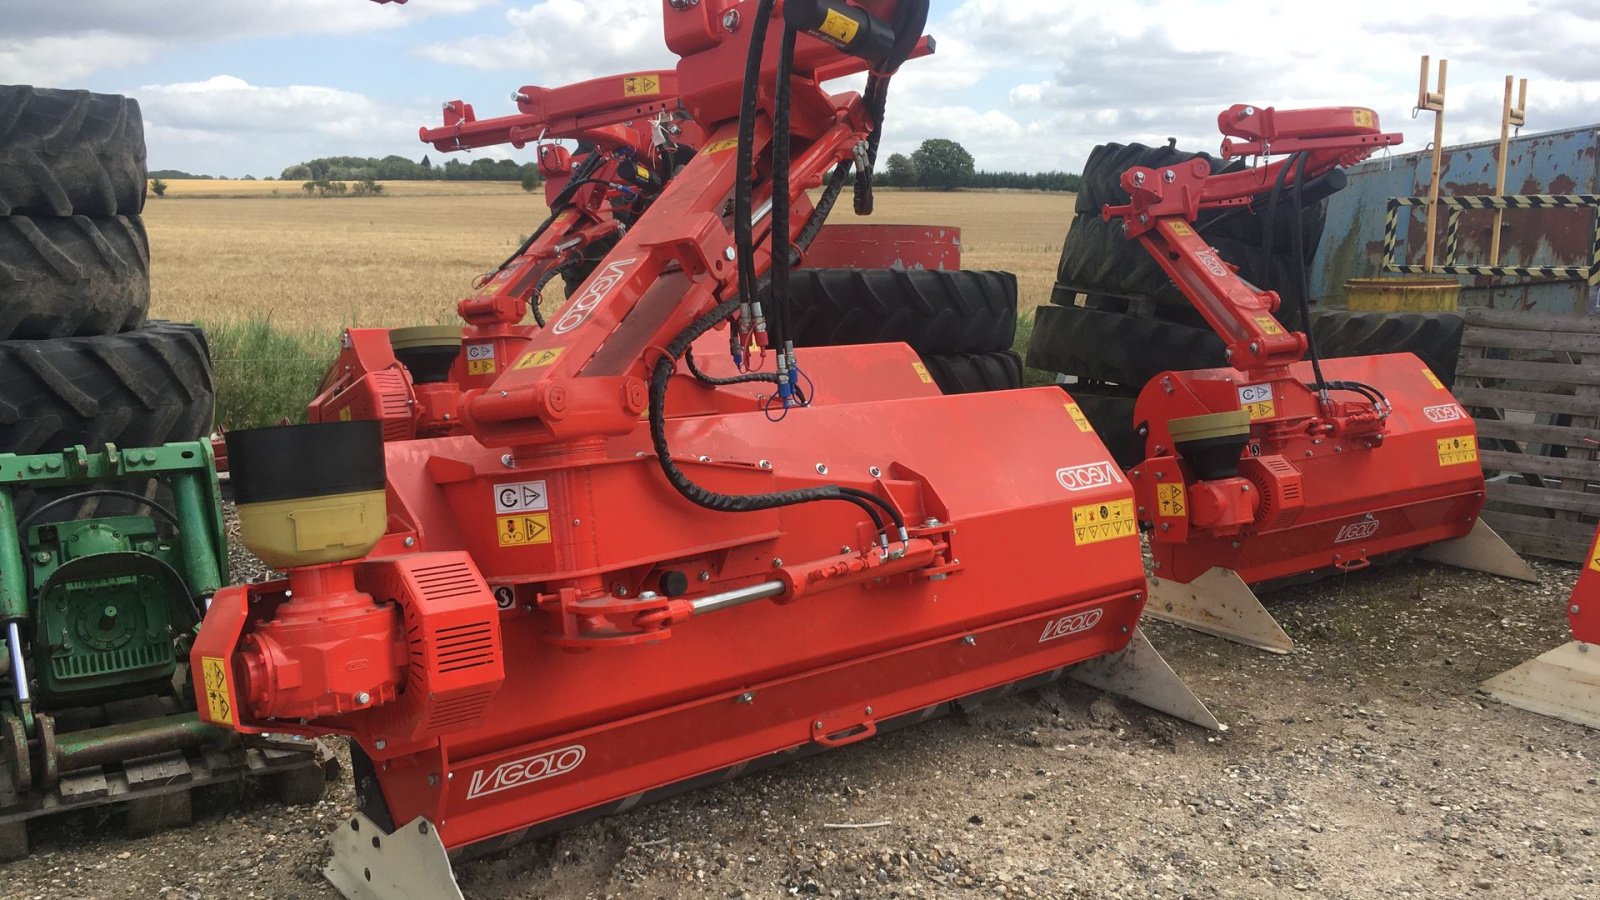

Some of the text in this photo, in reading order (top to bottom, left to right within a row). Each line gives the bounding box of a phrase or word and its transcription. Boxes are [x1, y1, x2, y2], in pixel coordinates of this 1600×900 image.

[552, 257, 637, 334] VIGOLO
[1423, 403, 1467, 423] VIGOLO
[1056, 461, 1123, 491] VIGOLO
[1334, 519, 1380, 543] VIGOLO
[1038, 607, 1103, 643] VIGOLO
[466, 744, 586, 800] VIGOLO
